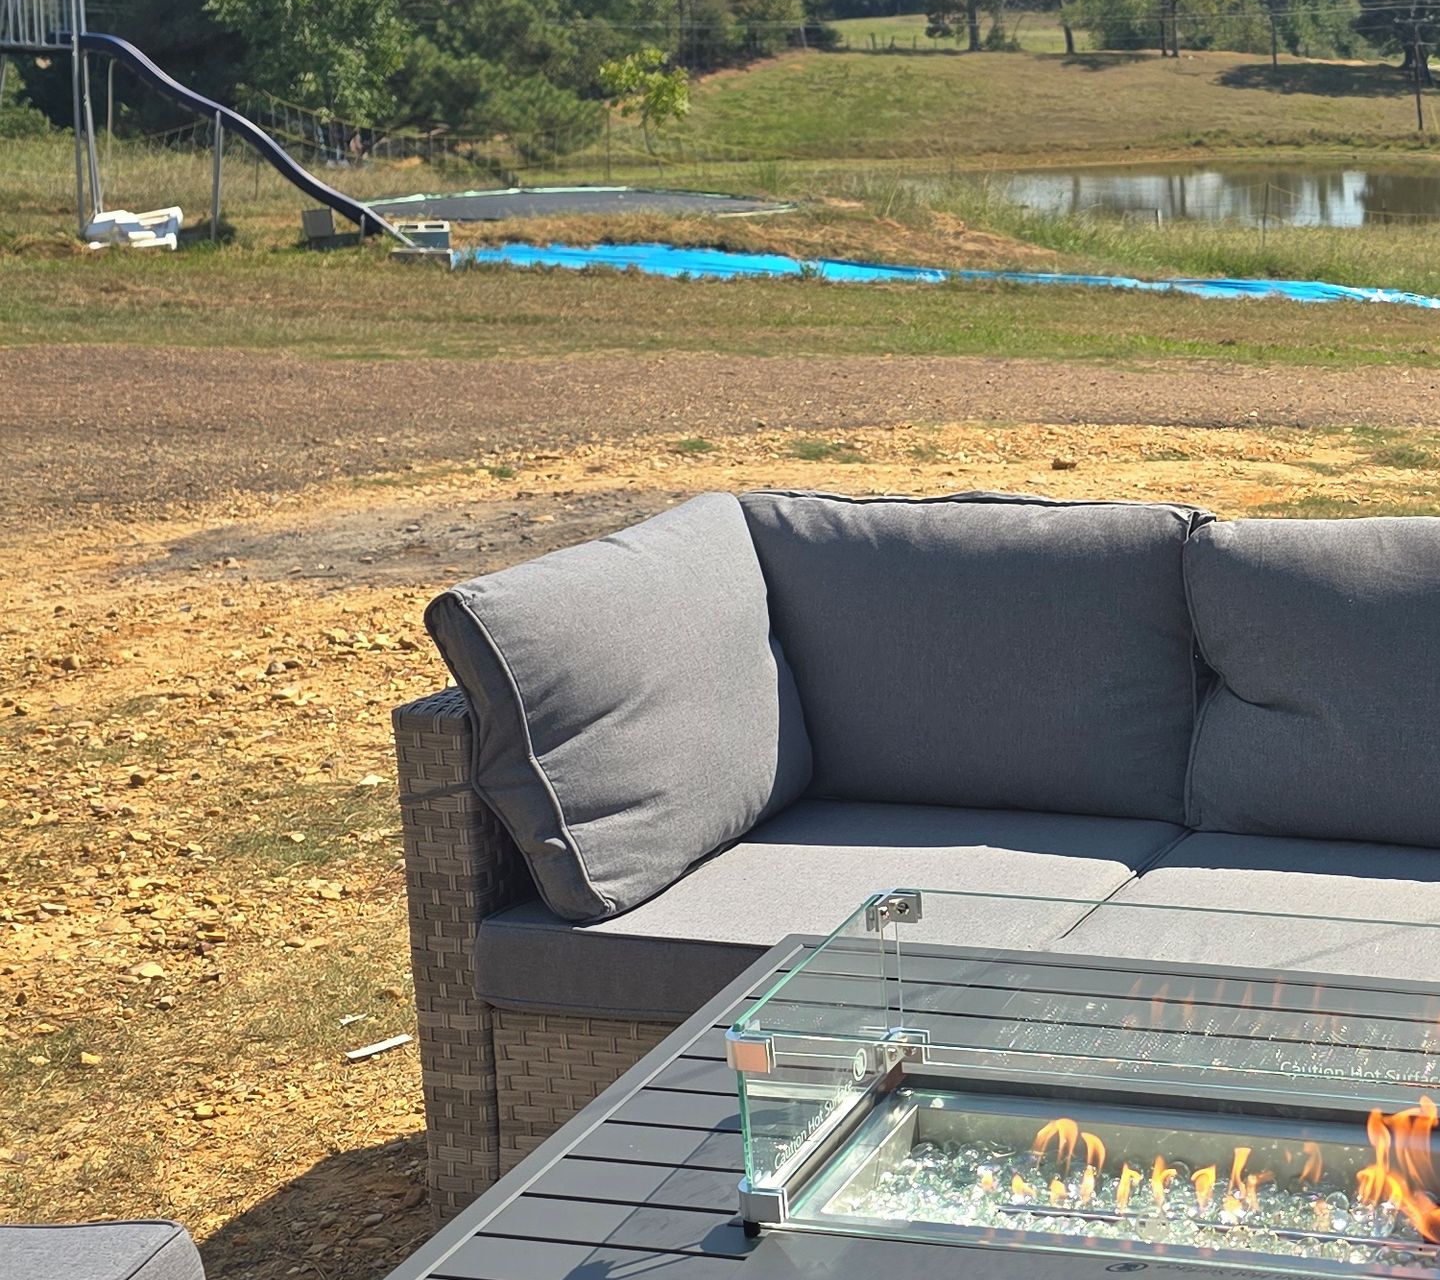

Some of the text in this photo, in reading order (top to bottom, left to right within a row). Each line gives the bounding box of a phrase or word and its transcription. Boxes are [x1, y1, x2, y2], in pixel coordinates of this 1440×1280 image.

[1280, 1061, 1345, 1076] Caution
[1350, 1066, 1381, 1079] Hot
[774, 1130, 807, 1170] Caution
[808, 1110, 824, 1134] Hot
